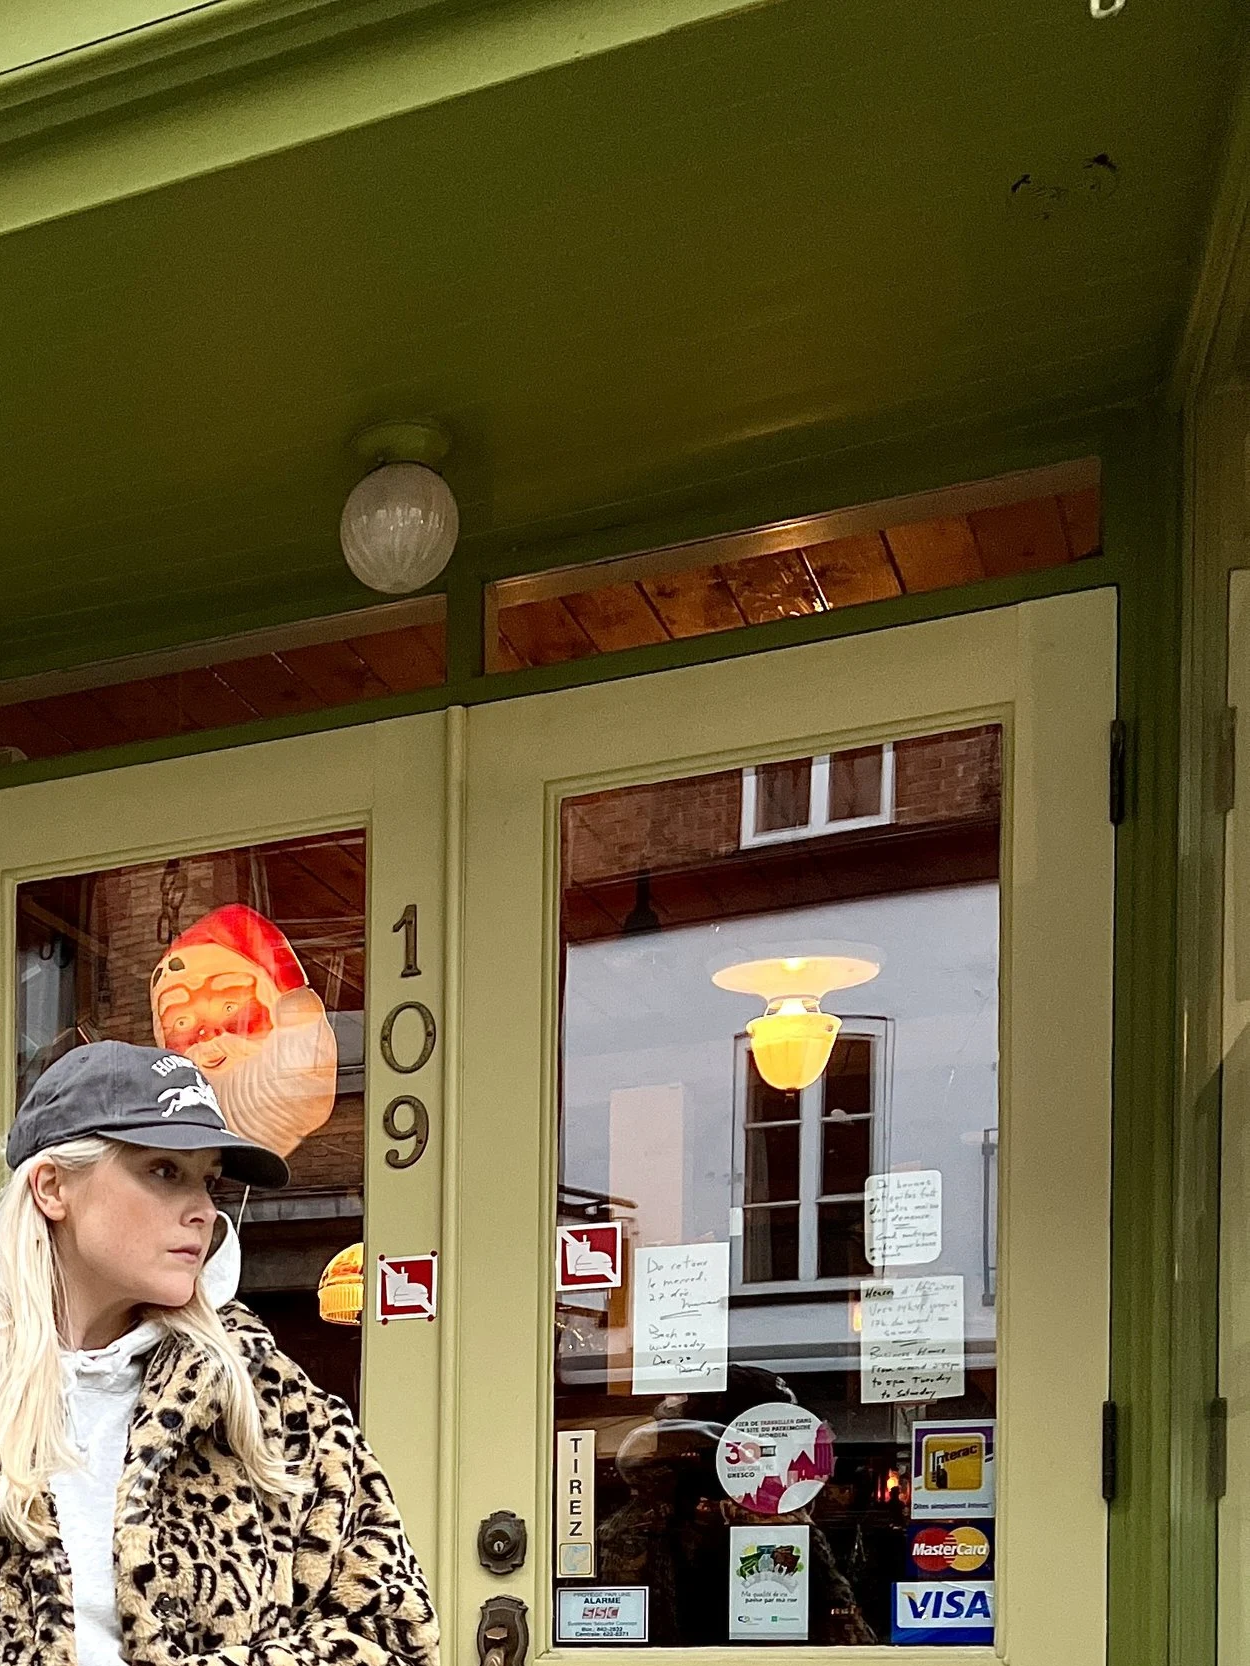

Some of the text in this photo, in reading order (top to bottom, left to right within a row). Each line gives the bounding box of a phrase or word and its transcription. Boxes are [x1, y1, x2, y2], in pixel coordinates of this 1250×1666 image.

[380, 904, 436, 1169] 109
[872, 1377, 882, 1388] to
[881, 1390, 890, 1399] to
[569, 1438, 582, 1536] TIREZ
[912, 1543, 988, 1556] MasterCard
[901, 1591, 991, 1619] VISA
